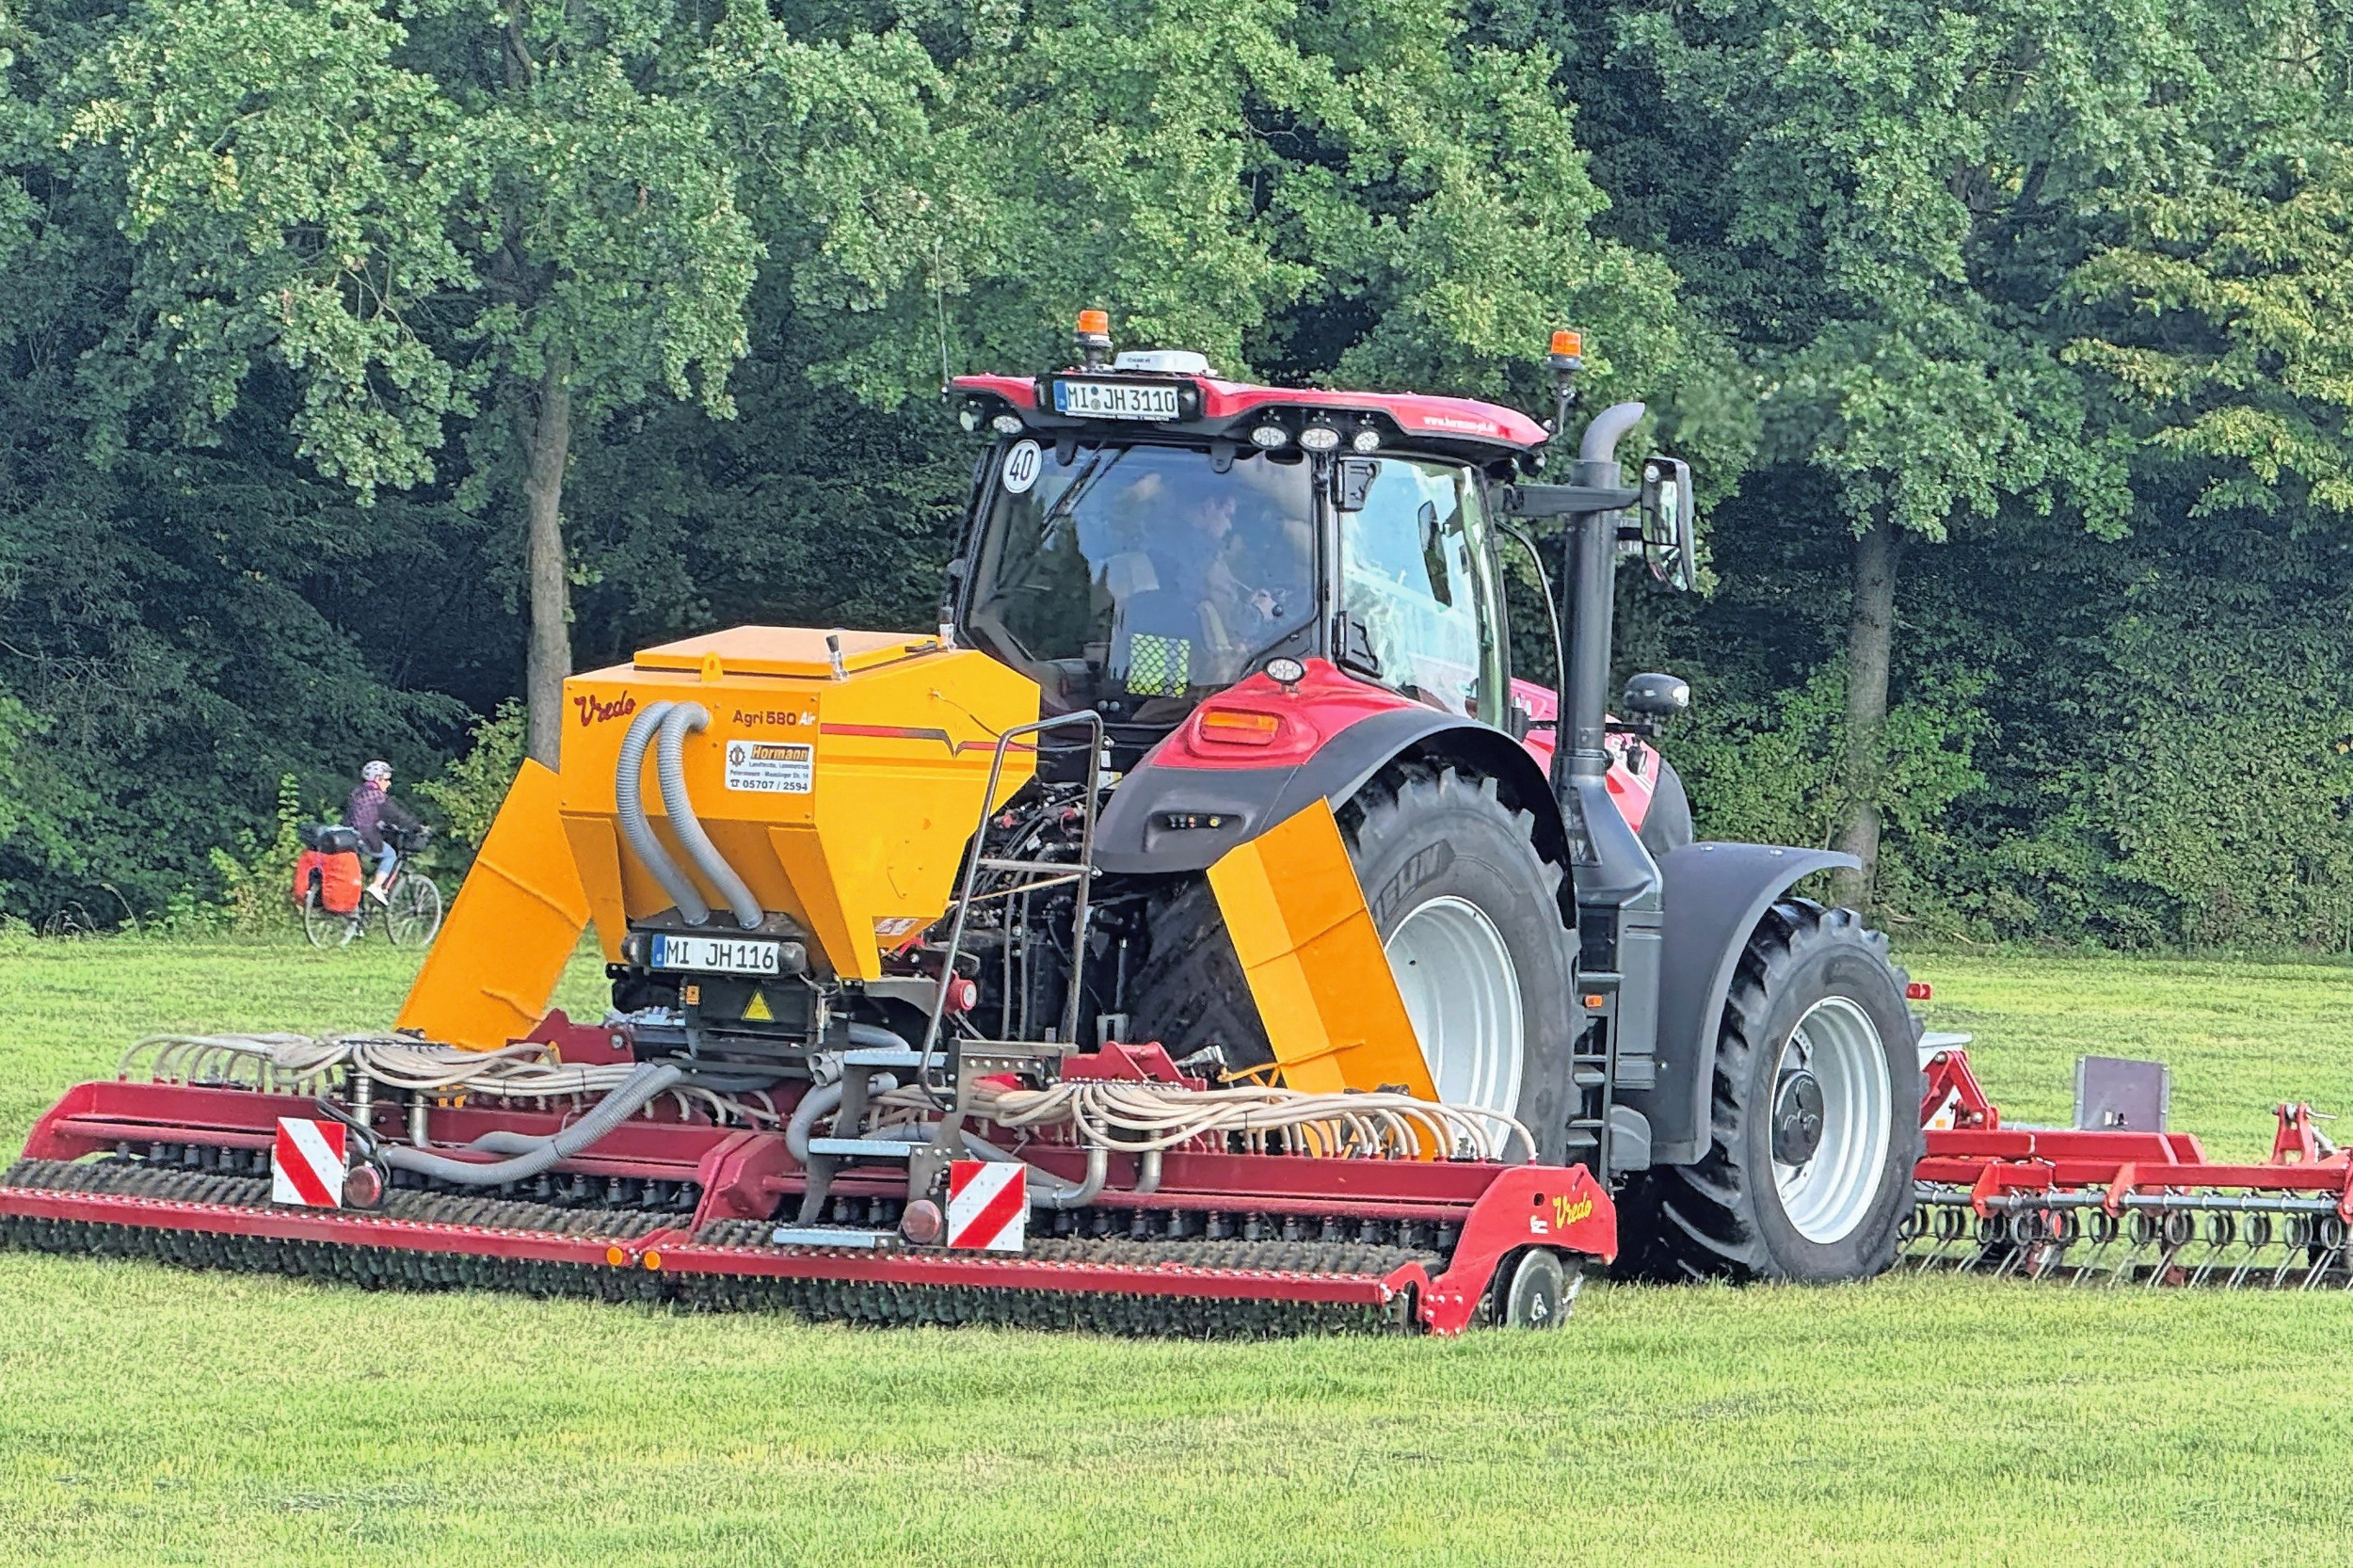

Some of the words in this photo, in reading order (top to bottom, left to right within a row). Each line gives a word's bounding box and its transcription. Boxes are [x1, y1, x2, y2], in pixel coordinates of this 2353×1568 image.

[1067, 387, 1089, 408] MI
[1104, 389, 1127, 411] JH
[1129, 390, 1176, 412] 3110
[1009, 449, 1034, 481] 40
[573, 690, 636, 727] Vredo
[732, 710, 763, 728] Agri
[752, 746, 808, 760] Hormann
[743, 779, 775, 789] 05707
[783, 781, 808, 791] 2594
[665, 939, 690, 965] MI
[705, 943, 732, 968] JH
[735, 944, 775, 969] 116
[1552, 1191, 1593, 1229] Vredo
